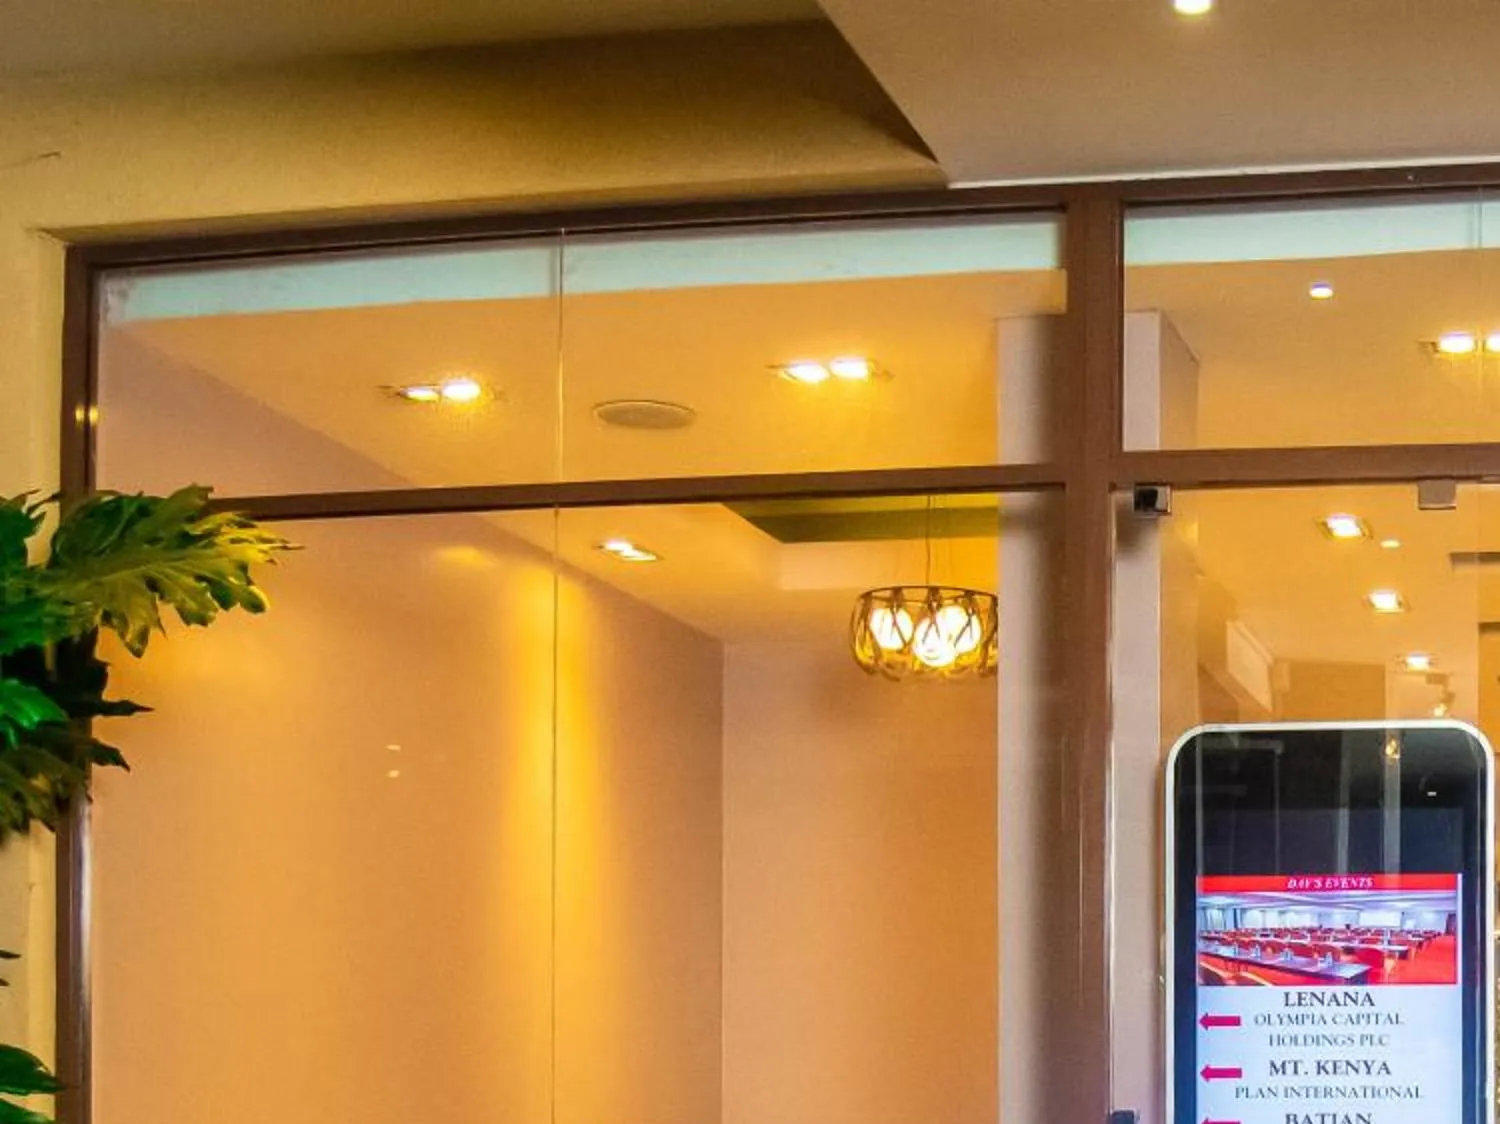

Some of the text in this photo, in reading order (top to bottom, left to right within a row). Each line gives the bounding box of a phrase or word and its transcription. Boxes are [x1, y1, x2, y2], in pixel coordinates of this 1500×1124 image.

[1324, 877, 1373, 889] EVENTS
[1283, 991, 1376, 1008] LENANA
[1253, 1012, 1404, 1026] OLYMPIA CAPITAL
[1268, 1033, 1391, 1047] HOLDINGS PLC
[1268, 1058, 1392, 1077] MT. KENYA
[1234, 1085, 1423, 1099] PLAN INTERNATIONAL
